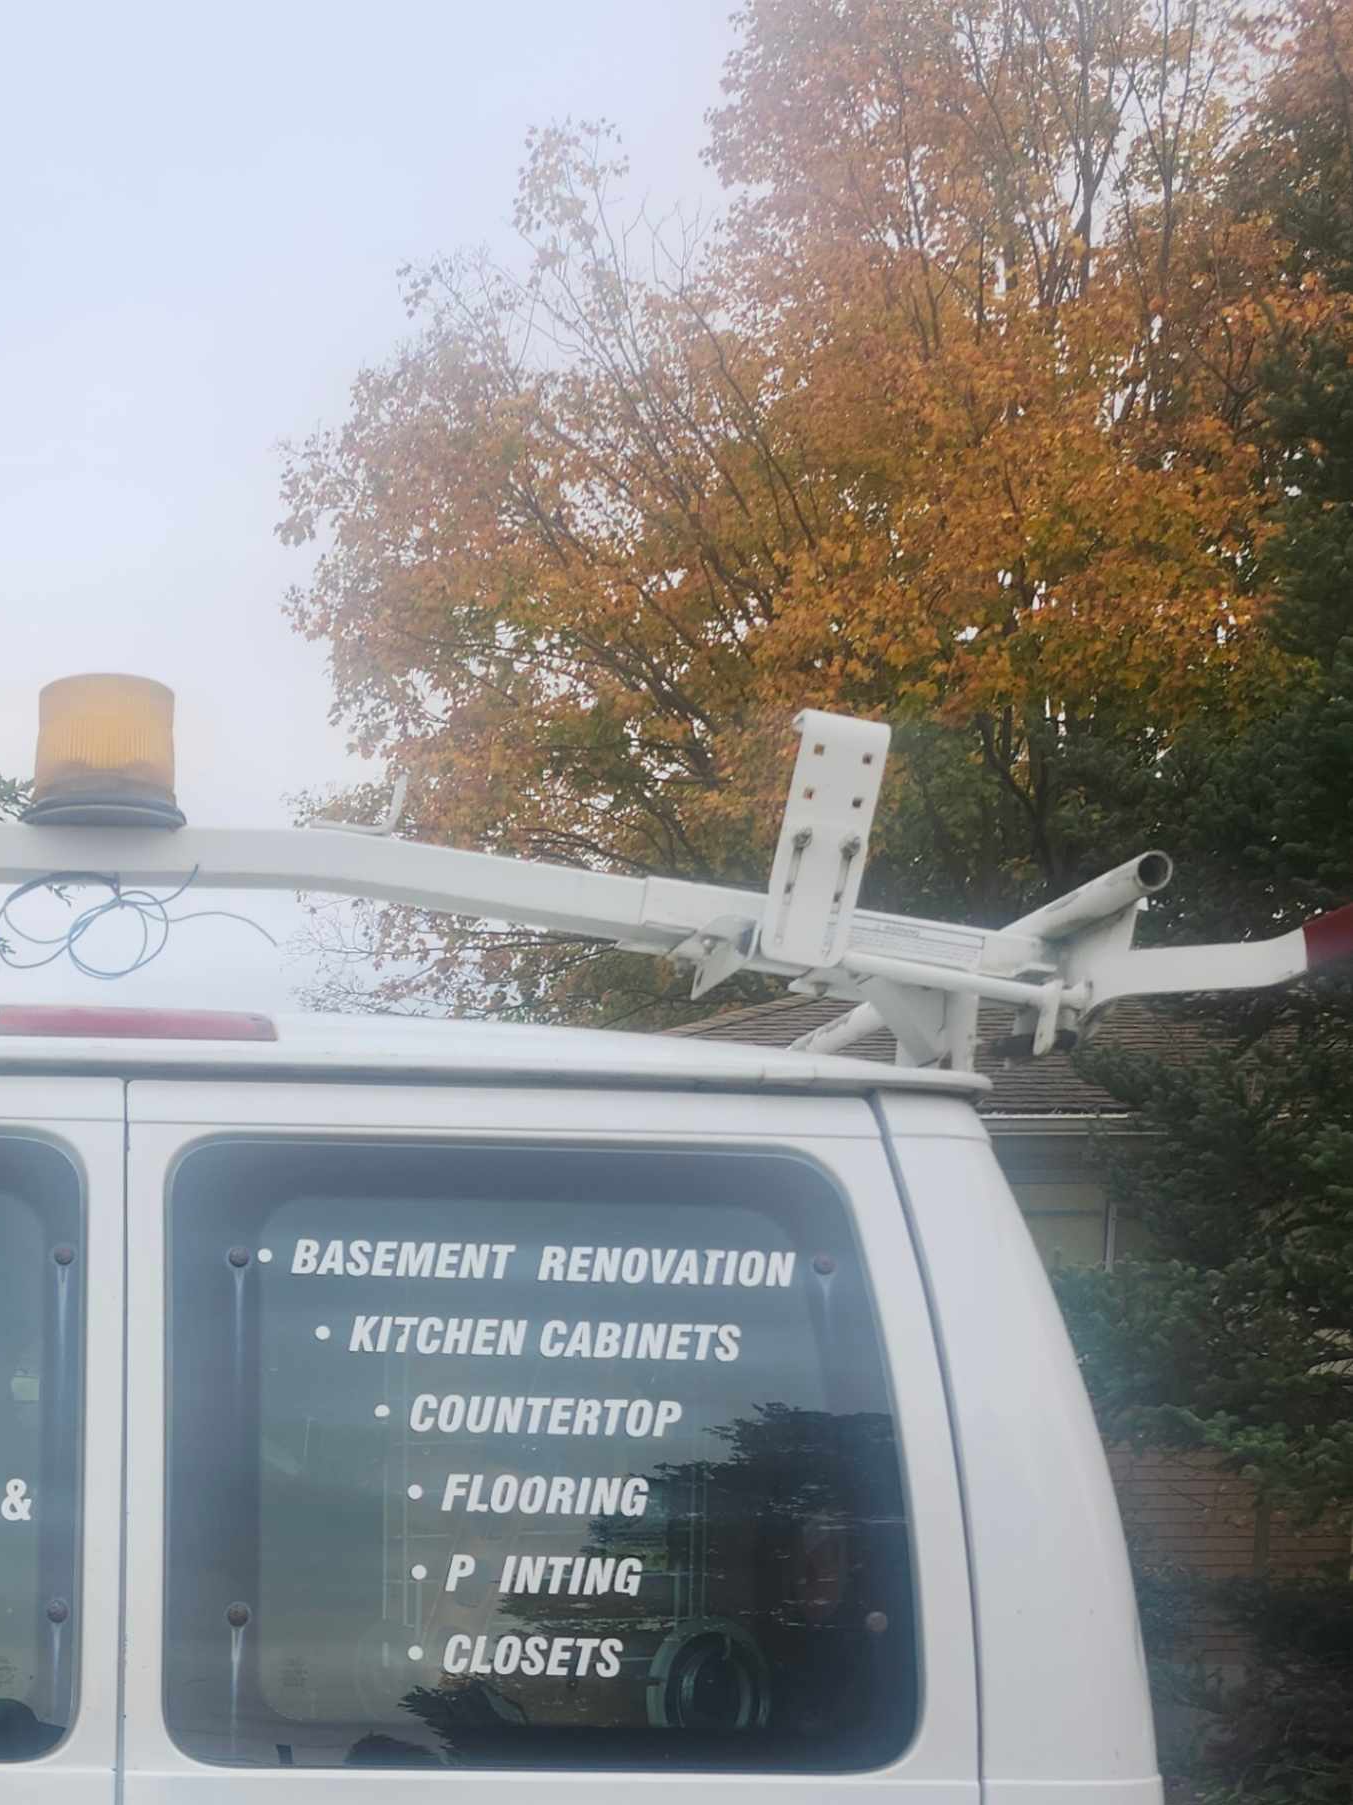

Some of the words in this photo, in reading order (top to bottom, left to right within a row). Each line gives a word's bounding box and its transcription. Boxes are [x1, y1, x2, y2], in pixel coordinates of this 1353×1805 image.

[292, 1239, 516, 1279] BASEMENT
[538, 1246, 796, 1287] RENOVATION
[349, 1316, 528, 1355] KITCHEN
[540, 1320, 742, 1361] CABINETS
[410, 1394, 682, 1437] COUNTERTOP
[0, 1479, 32, 1521] &
[442, 1474, 649, 1517] FLOORING
[446, 1555, 643, 1596] PINTING
[444, 1635, 623, 1677] CLOSETS
